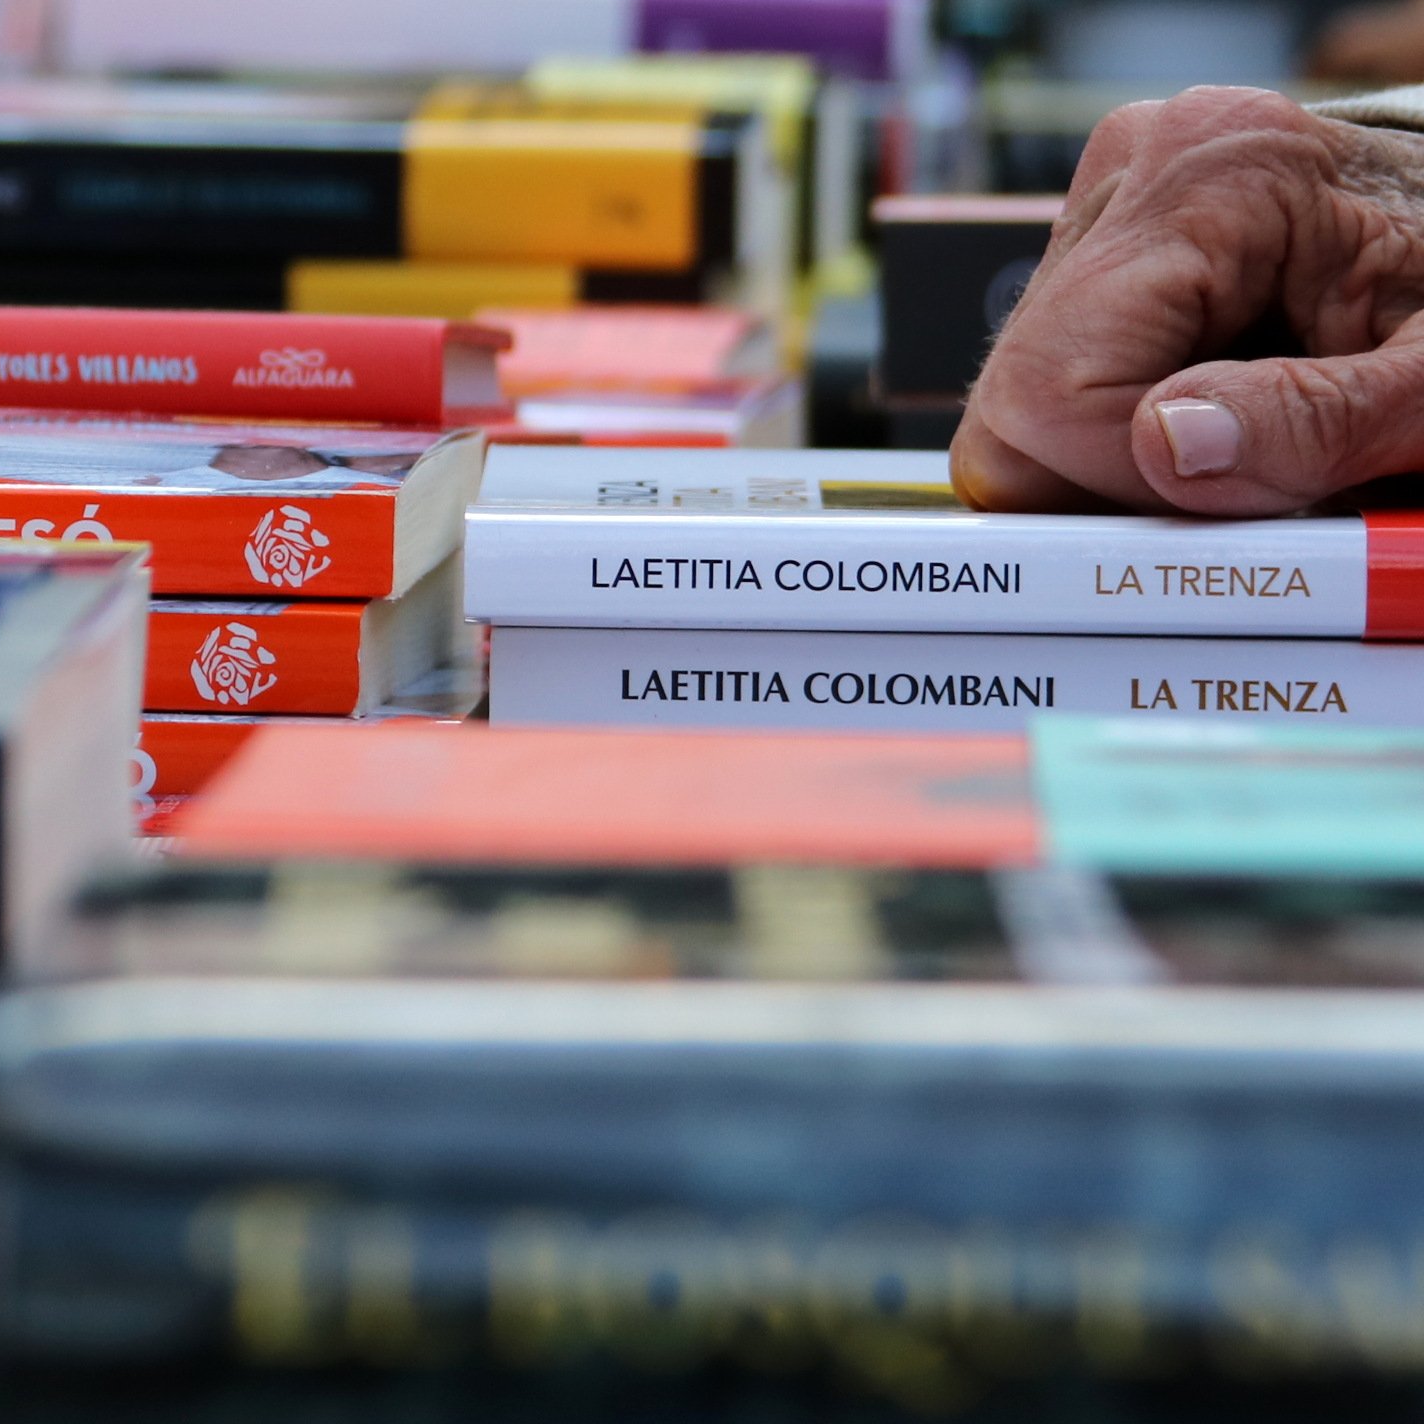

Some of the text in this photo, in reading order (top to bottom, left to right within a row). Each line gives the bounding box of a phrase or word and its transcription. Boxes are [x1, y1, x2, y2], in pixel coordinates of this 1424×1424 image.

[77, 354, 198, 385] VILLANOS
[231, 367, 356, 389] ALFAGUARA
[592, 558, 1311, 598] LAETITIA COLOMBANI LA TRENZA
[621, 669, 1348, 713] LAETITIA COLOMBANI LA TRENZA
